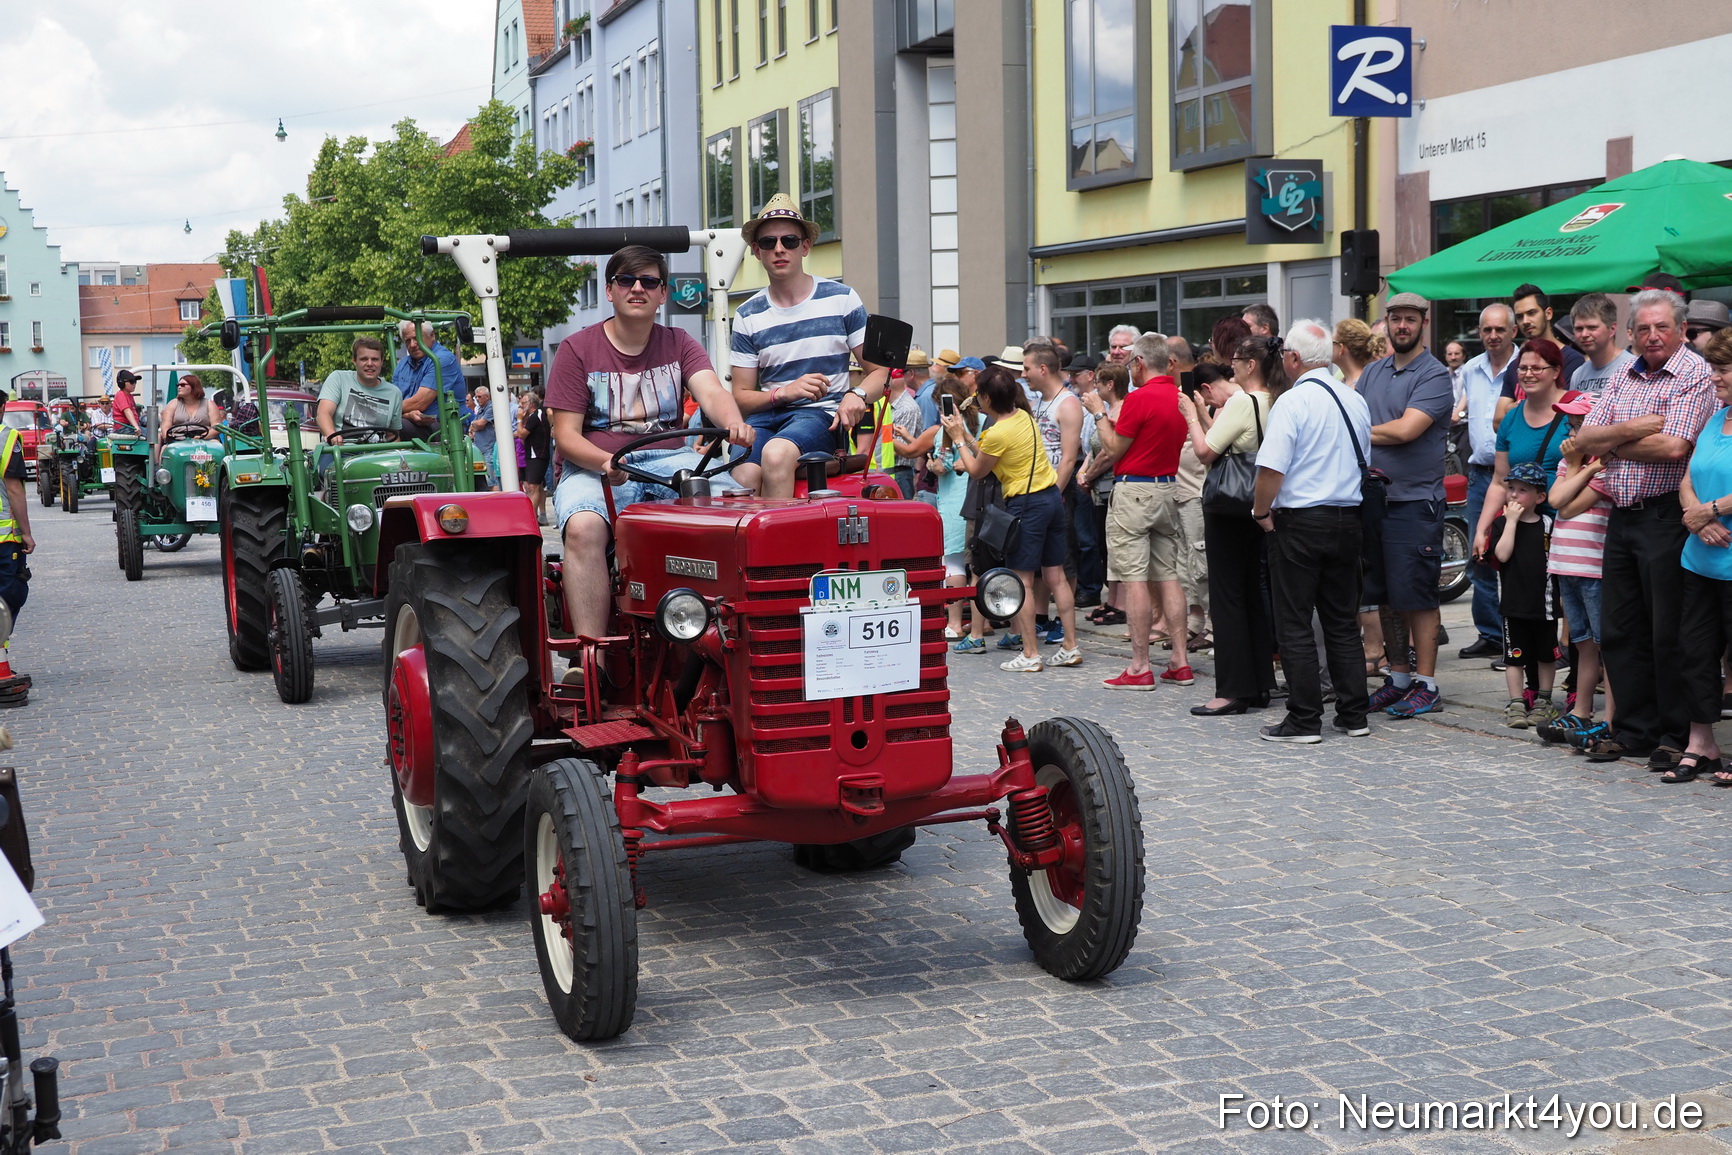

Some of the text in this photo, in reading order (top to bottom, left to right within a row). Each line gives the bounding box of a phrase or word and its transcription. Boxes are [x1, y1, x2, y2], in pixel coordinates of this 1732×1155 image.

[1419, 132, 1487, 159] Unterer Markt 15
[1278, 181, 1306, 216] G2
[1511, 234, 1599, 248] Neumarkter
[1476, 243, 1597, 263] Lammsbräu
[681, 283, 696, 302] G2
[190, 453, 212, 461] Kramer
[381, 471, 429, 485] FENDT
[818, 590, 825, 599] D
[831, 576, 861, 601] NM
[862, 619, 900, 641] 516
